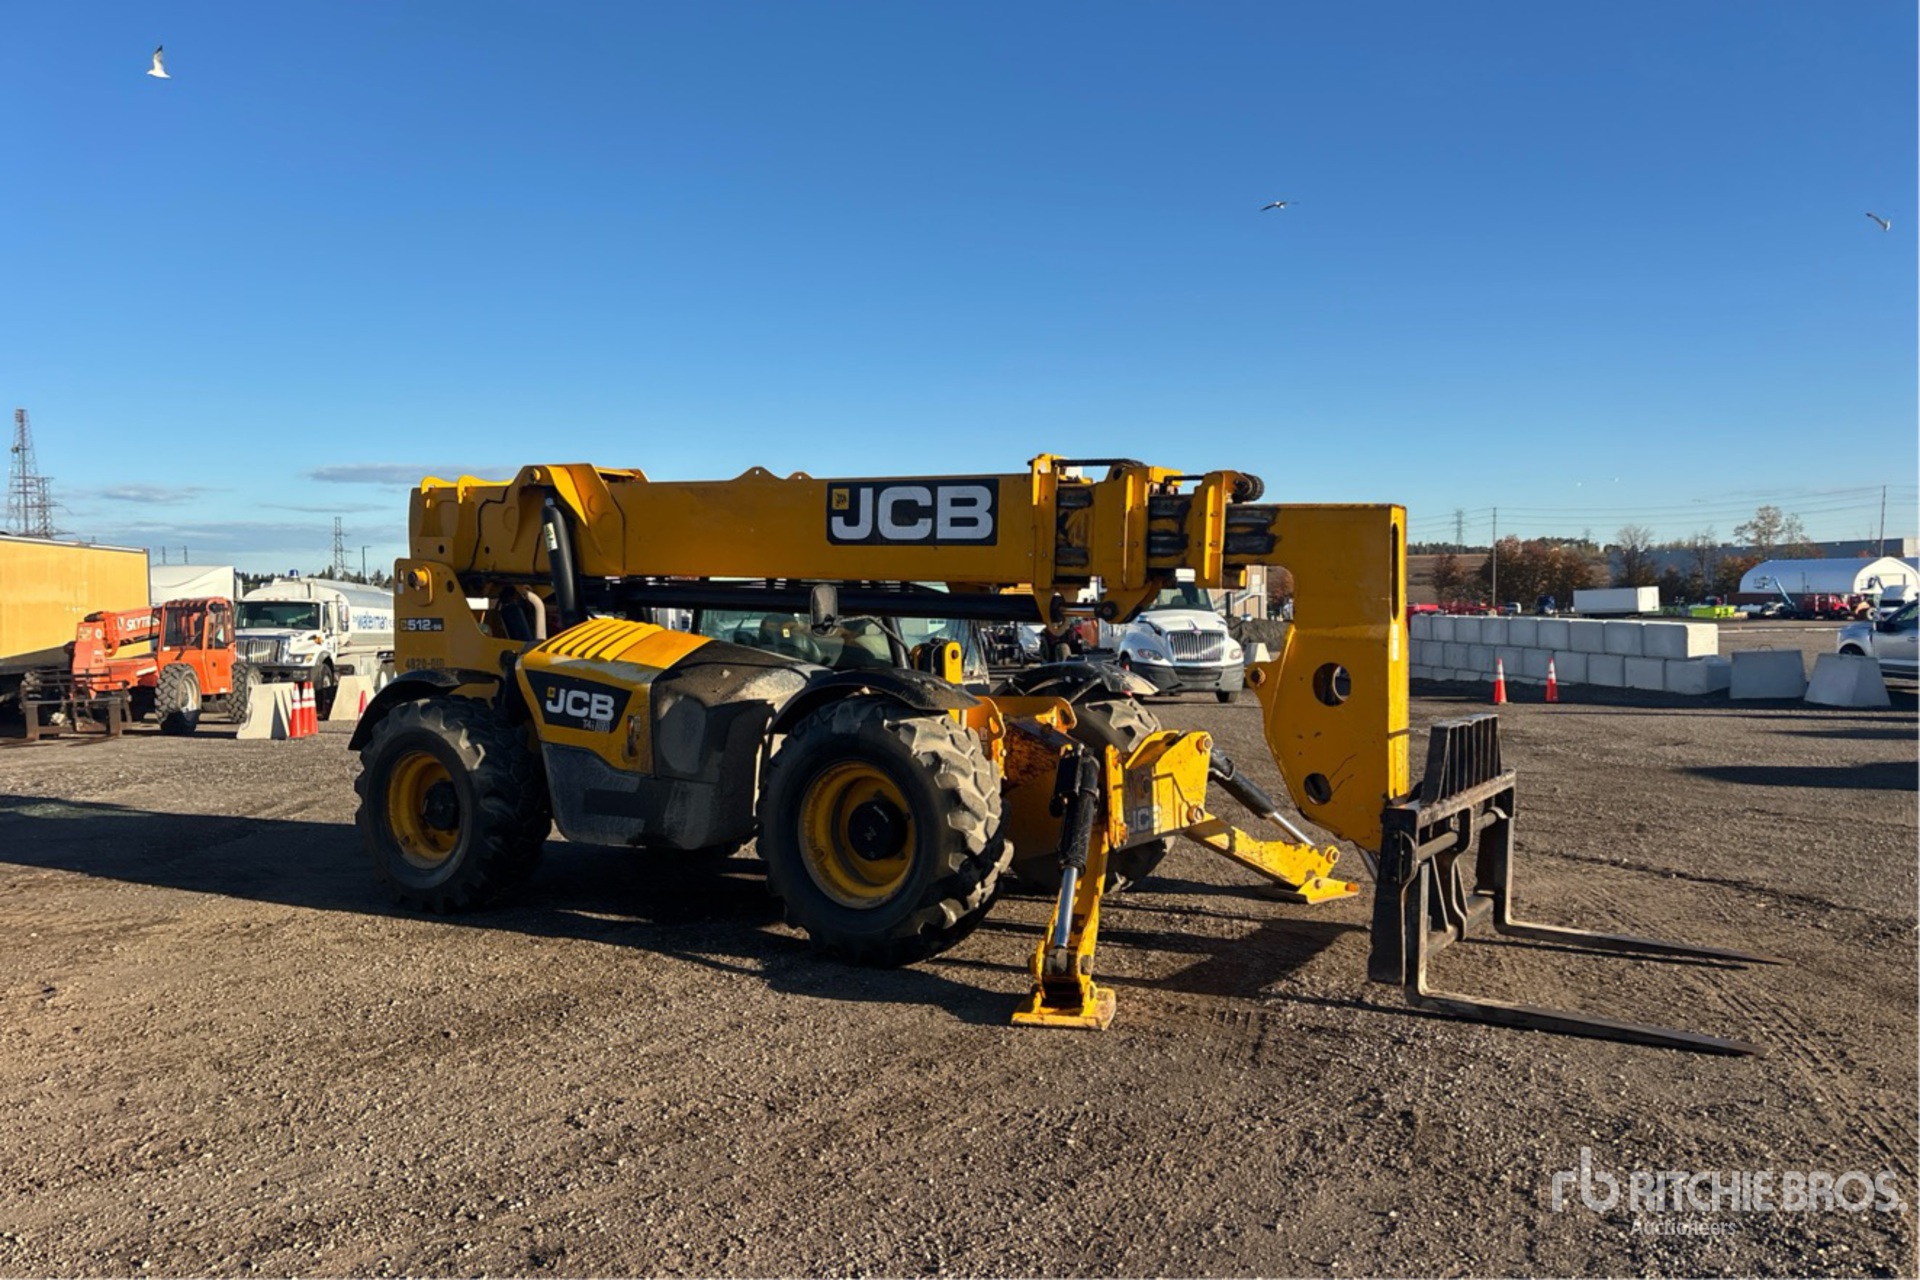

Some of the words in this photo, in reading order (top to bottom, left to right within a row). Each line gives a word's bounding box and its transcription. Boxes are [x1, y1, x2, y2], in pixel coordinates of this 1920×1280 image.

[831, 485, 993, 540] JCB
[126, 615, 160, 631] SKYTR
[546, 688, 614, 721] JCB
